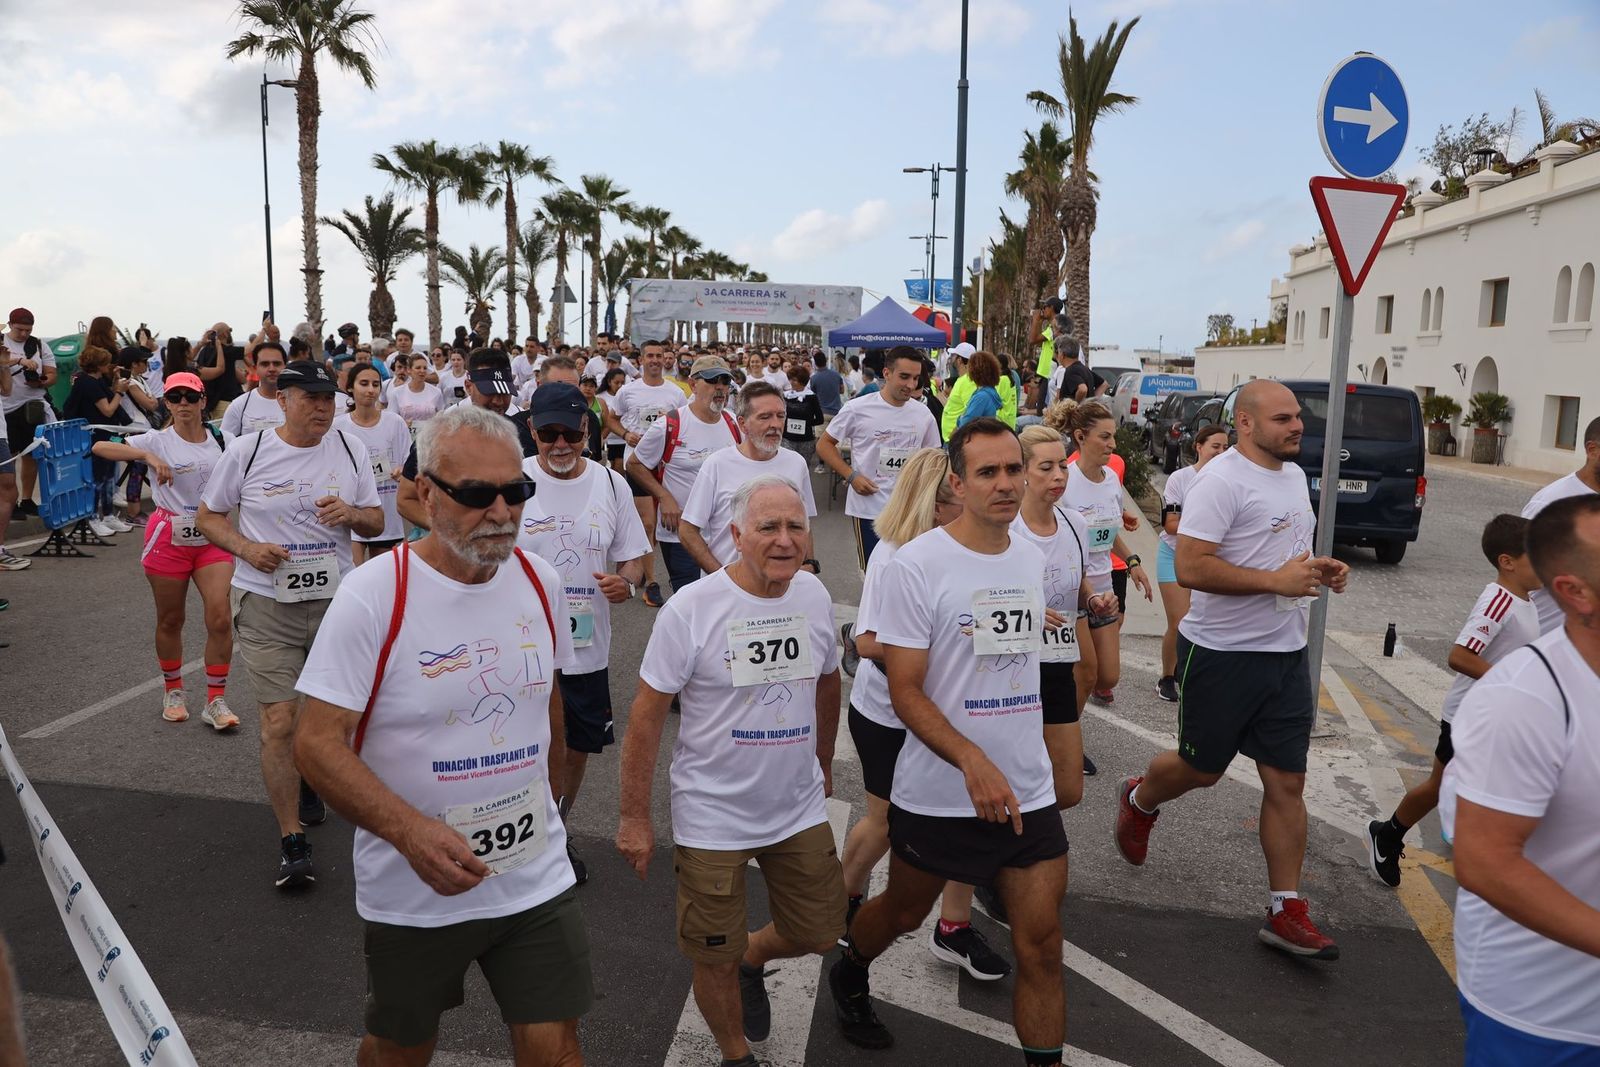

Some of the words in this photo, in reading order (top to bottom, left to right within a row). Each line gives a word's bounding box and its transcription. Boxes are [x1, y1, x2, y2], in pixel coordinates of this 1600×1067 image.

[704, 288, 718, 296] 3A
[720, 288, 770, 298] CARRERA
[773, 290, 787, 299] 5K
[851, 334, 924, 343] info@dorsalchip.es
[1346, 481, 1363, 490] HNR
[1096, 529, 1110, 541] 38
[287, 571, 329, 590] 295
[757, 617, 786, 626] CARRERA
[991, 609, 1032, 634] 371
[748, 637, 800, 664] 370
[965, 698, 1000, 709] DONACIÓN
[1002, 694, 1037, 707] TRASPLANTE
[732, 729, 765, 739] DONACIÓN
[767, 727, 801, 739] TRASPLANTE
[432, 757, 478, 773] DONACIÓN
[480, 748, 525, 768] TRASPLANTE
[526, 744, 539, 758] VIDA
[437, 772, 469, 782] Memorial
[470, 770, 493, 779] Vicente
[494, 763, 520, 775] Granados
[485, 794, 521, 811] CARRERA
[471, 813, 534, 857] 392
